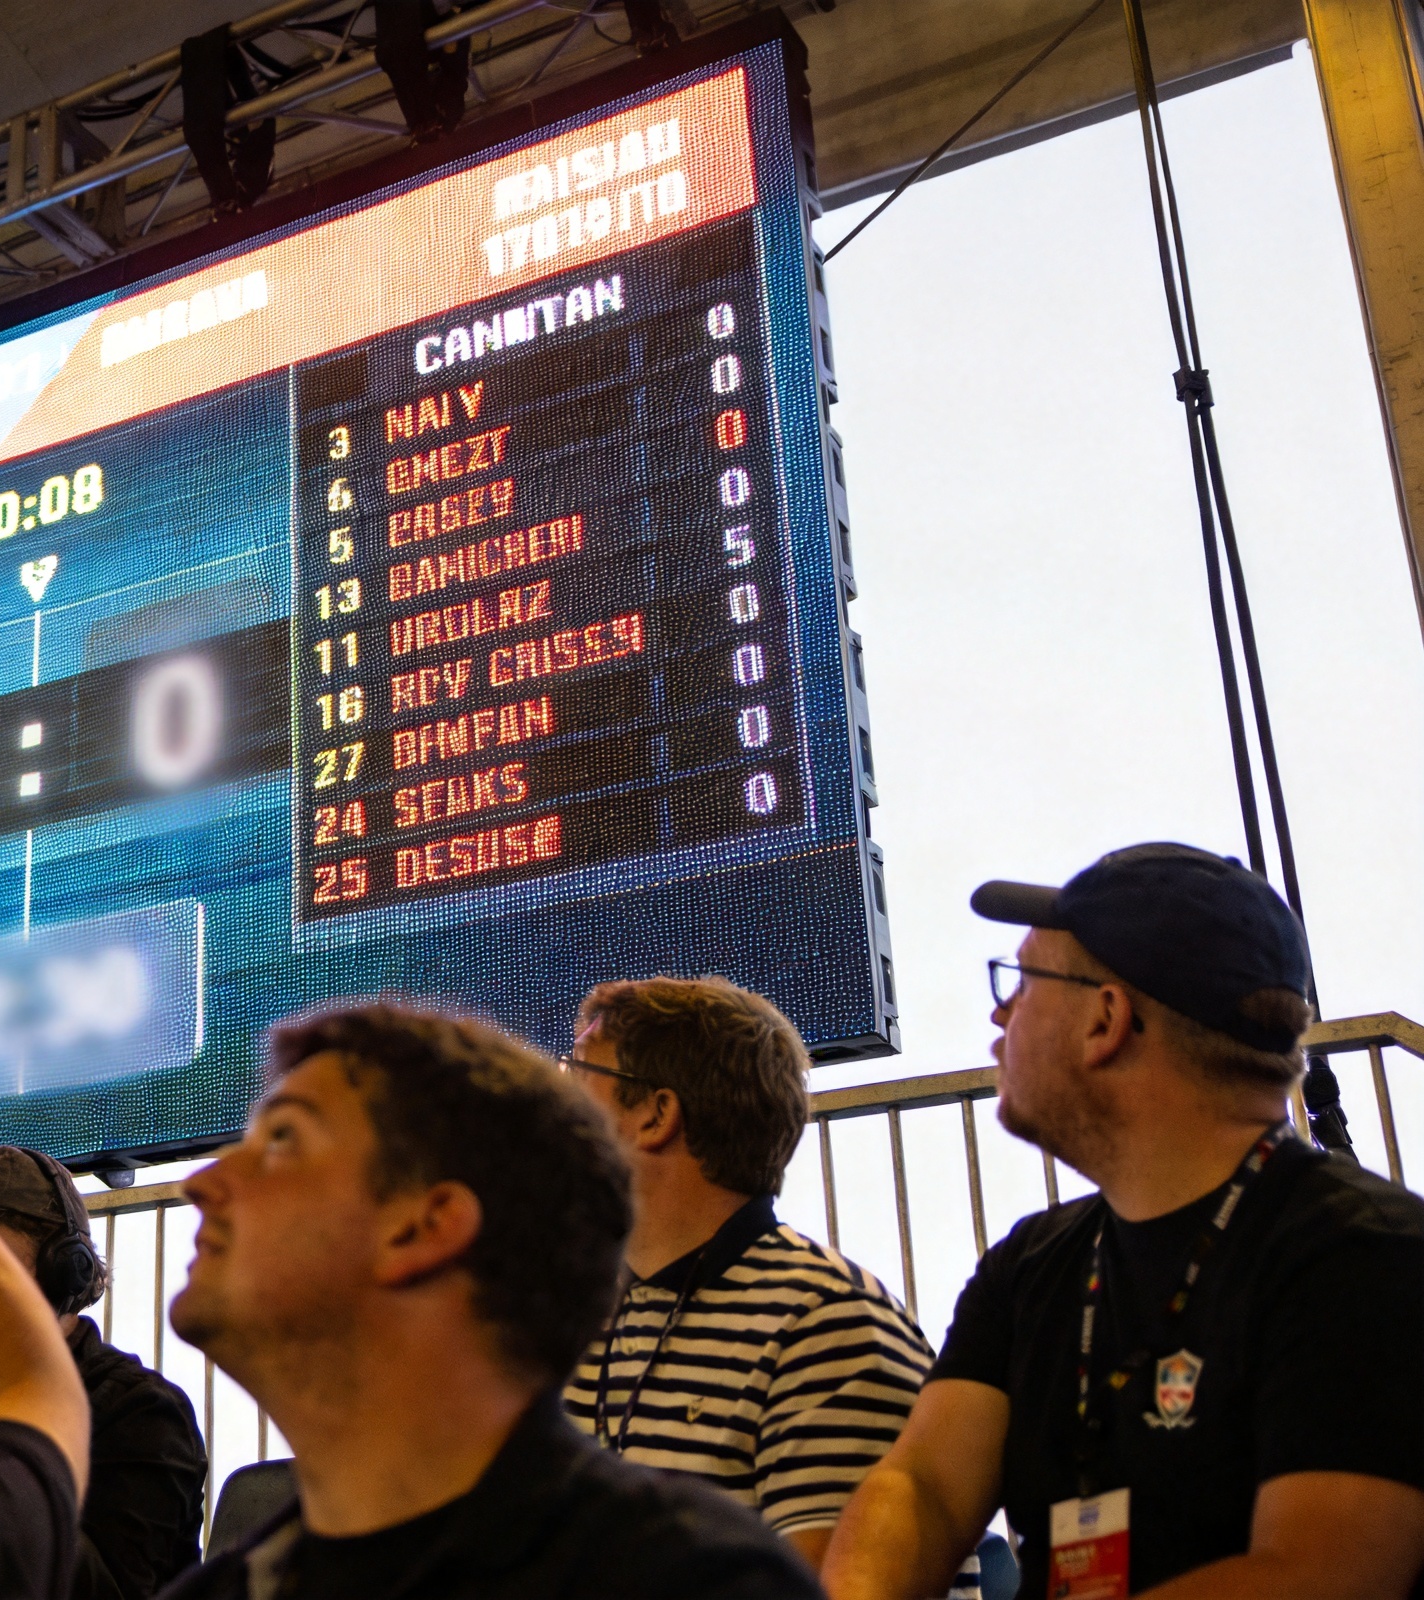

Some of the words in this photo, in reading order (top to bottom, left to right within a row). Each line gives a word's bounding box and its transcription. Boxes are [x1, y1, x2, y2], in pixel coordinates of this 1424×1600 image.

[327, 477, 353, 512] 6
[711, 354, 741, 394] 0
[329, 426, 351, 460] 3
[314, 632, 358, 675] 11
[722, 524, 757, 566] 5
[315, 577, 361, 620] 13
[718, 466, 751, 507] 0
[329, 526, 354, 564] 5
[729, 583, 759, 625] 0
[313, 742, 365, 789] 27
[733, 642, 765, 686] 0
[313, 801, 366, 846] 24
[737, 704, 770, 749] 0
[313, 858, 368, 904] 25
[743, 771, 777, 815] 0
